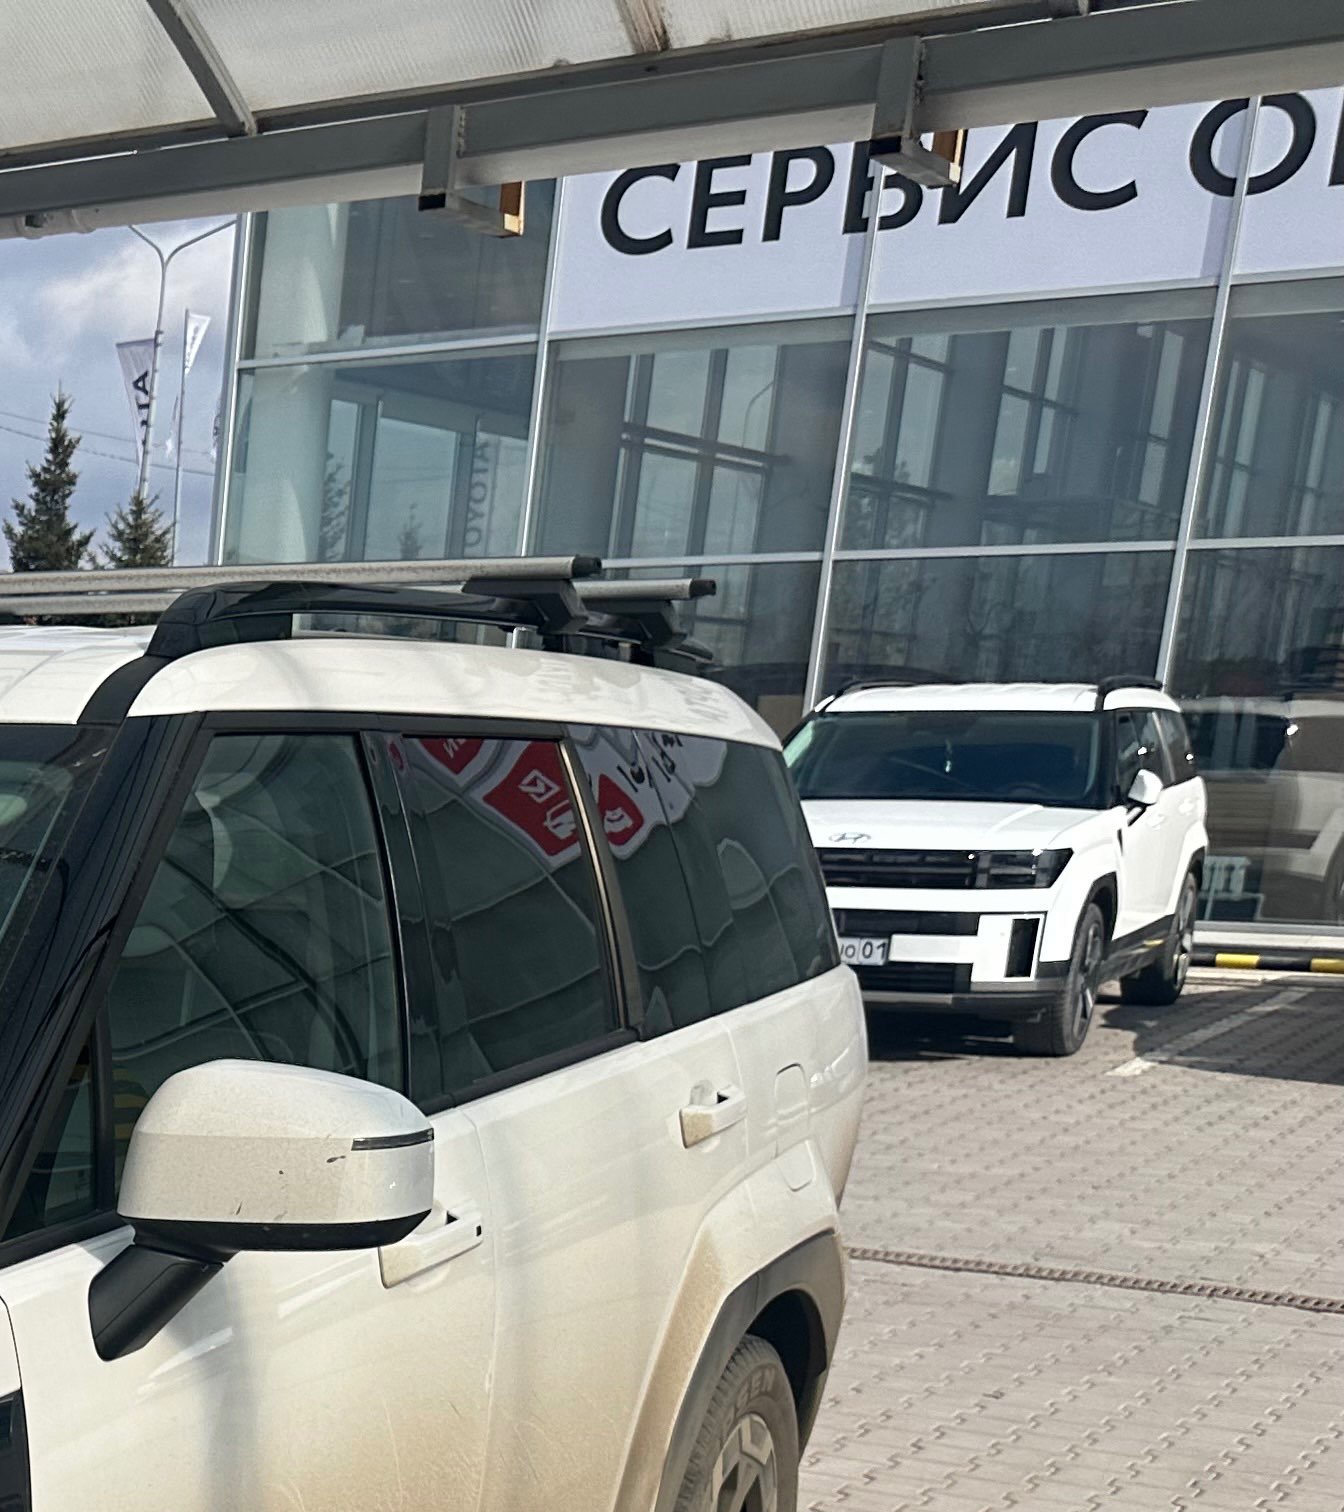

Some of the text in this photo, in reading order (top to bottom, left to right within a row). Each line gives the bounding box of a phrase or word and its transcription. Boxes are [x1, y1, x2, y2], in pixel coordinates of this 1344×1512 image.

[600, 91, 1344, 256] СЕРВИС О
[862, 941, 888, 959] 01
